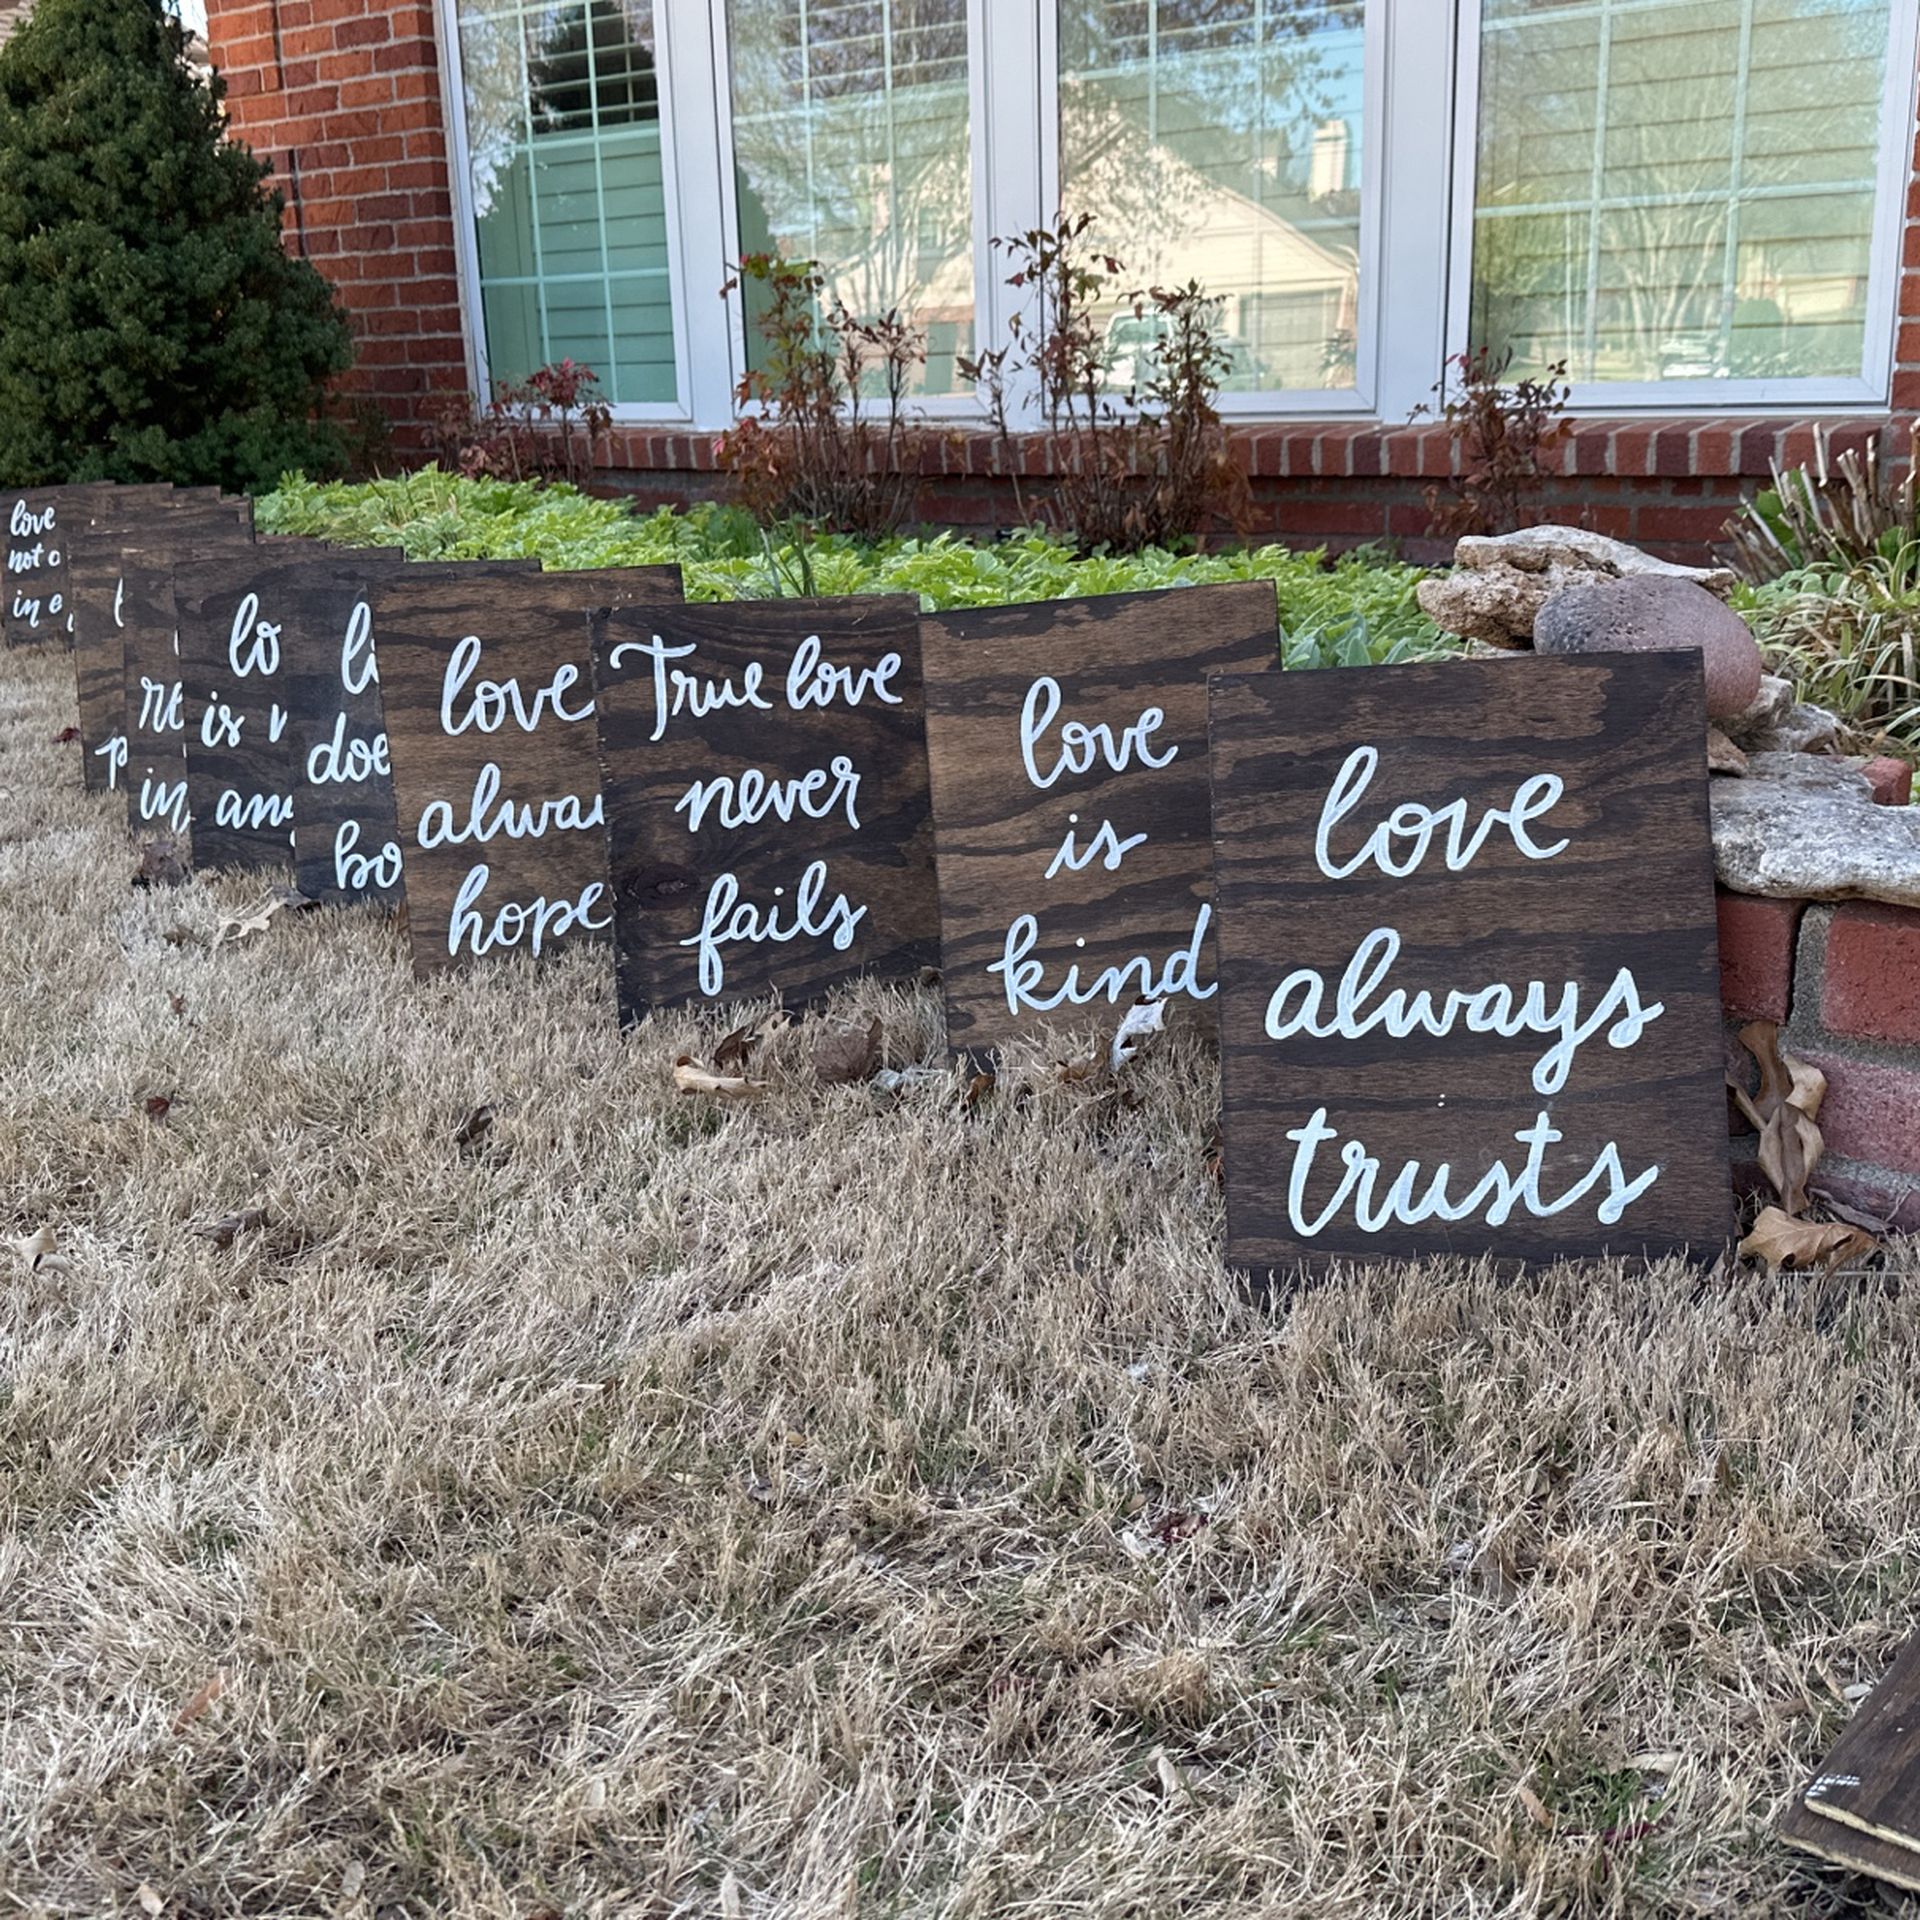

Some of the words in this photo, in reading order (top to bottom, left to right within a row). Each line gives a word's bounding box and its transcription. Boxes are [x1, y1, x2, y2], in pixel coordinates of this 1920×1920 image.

[8, 542, 44, 574] not
[10, 499, 56, 537] love
[13, 589, 40, 628] in
[201, 690, 246, 748] is
[440, 635, 596, 736] love
[609, 634, 774, 741] True
[786, 635, 903, 710] love
[1020, 676, 1179, 789] love
[674, 755, 861, 833] never
[1314, 745, 1570, 880] love
[1044, 813, 1148, 879] is
[448, 864, 613, 957] hope
[680, 861, 868, 997] fails
[987, 903, 1218, 1016] kind
[1264, 927, 1665, 1095] always
[1286, 1107, 1660, 1238] trusts
